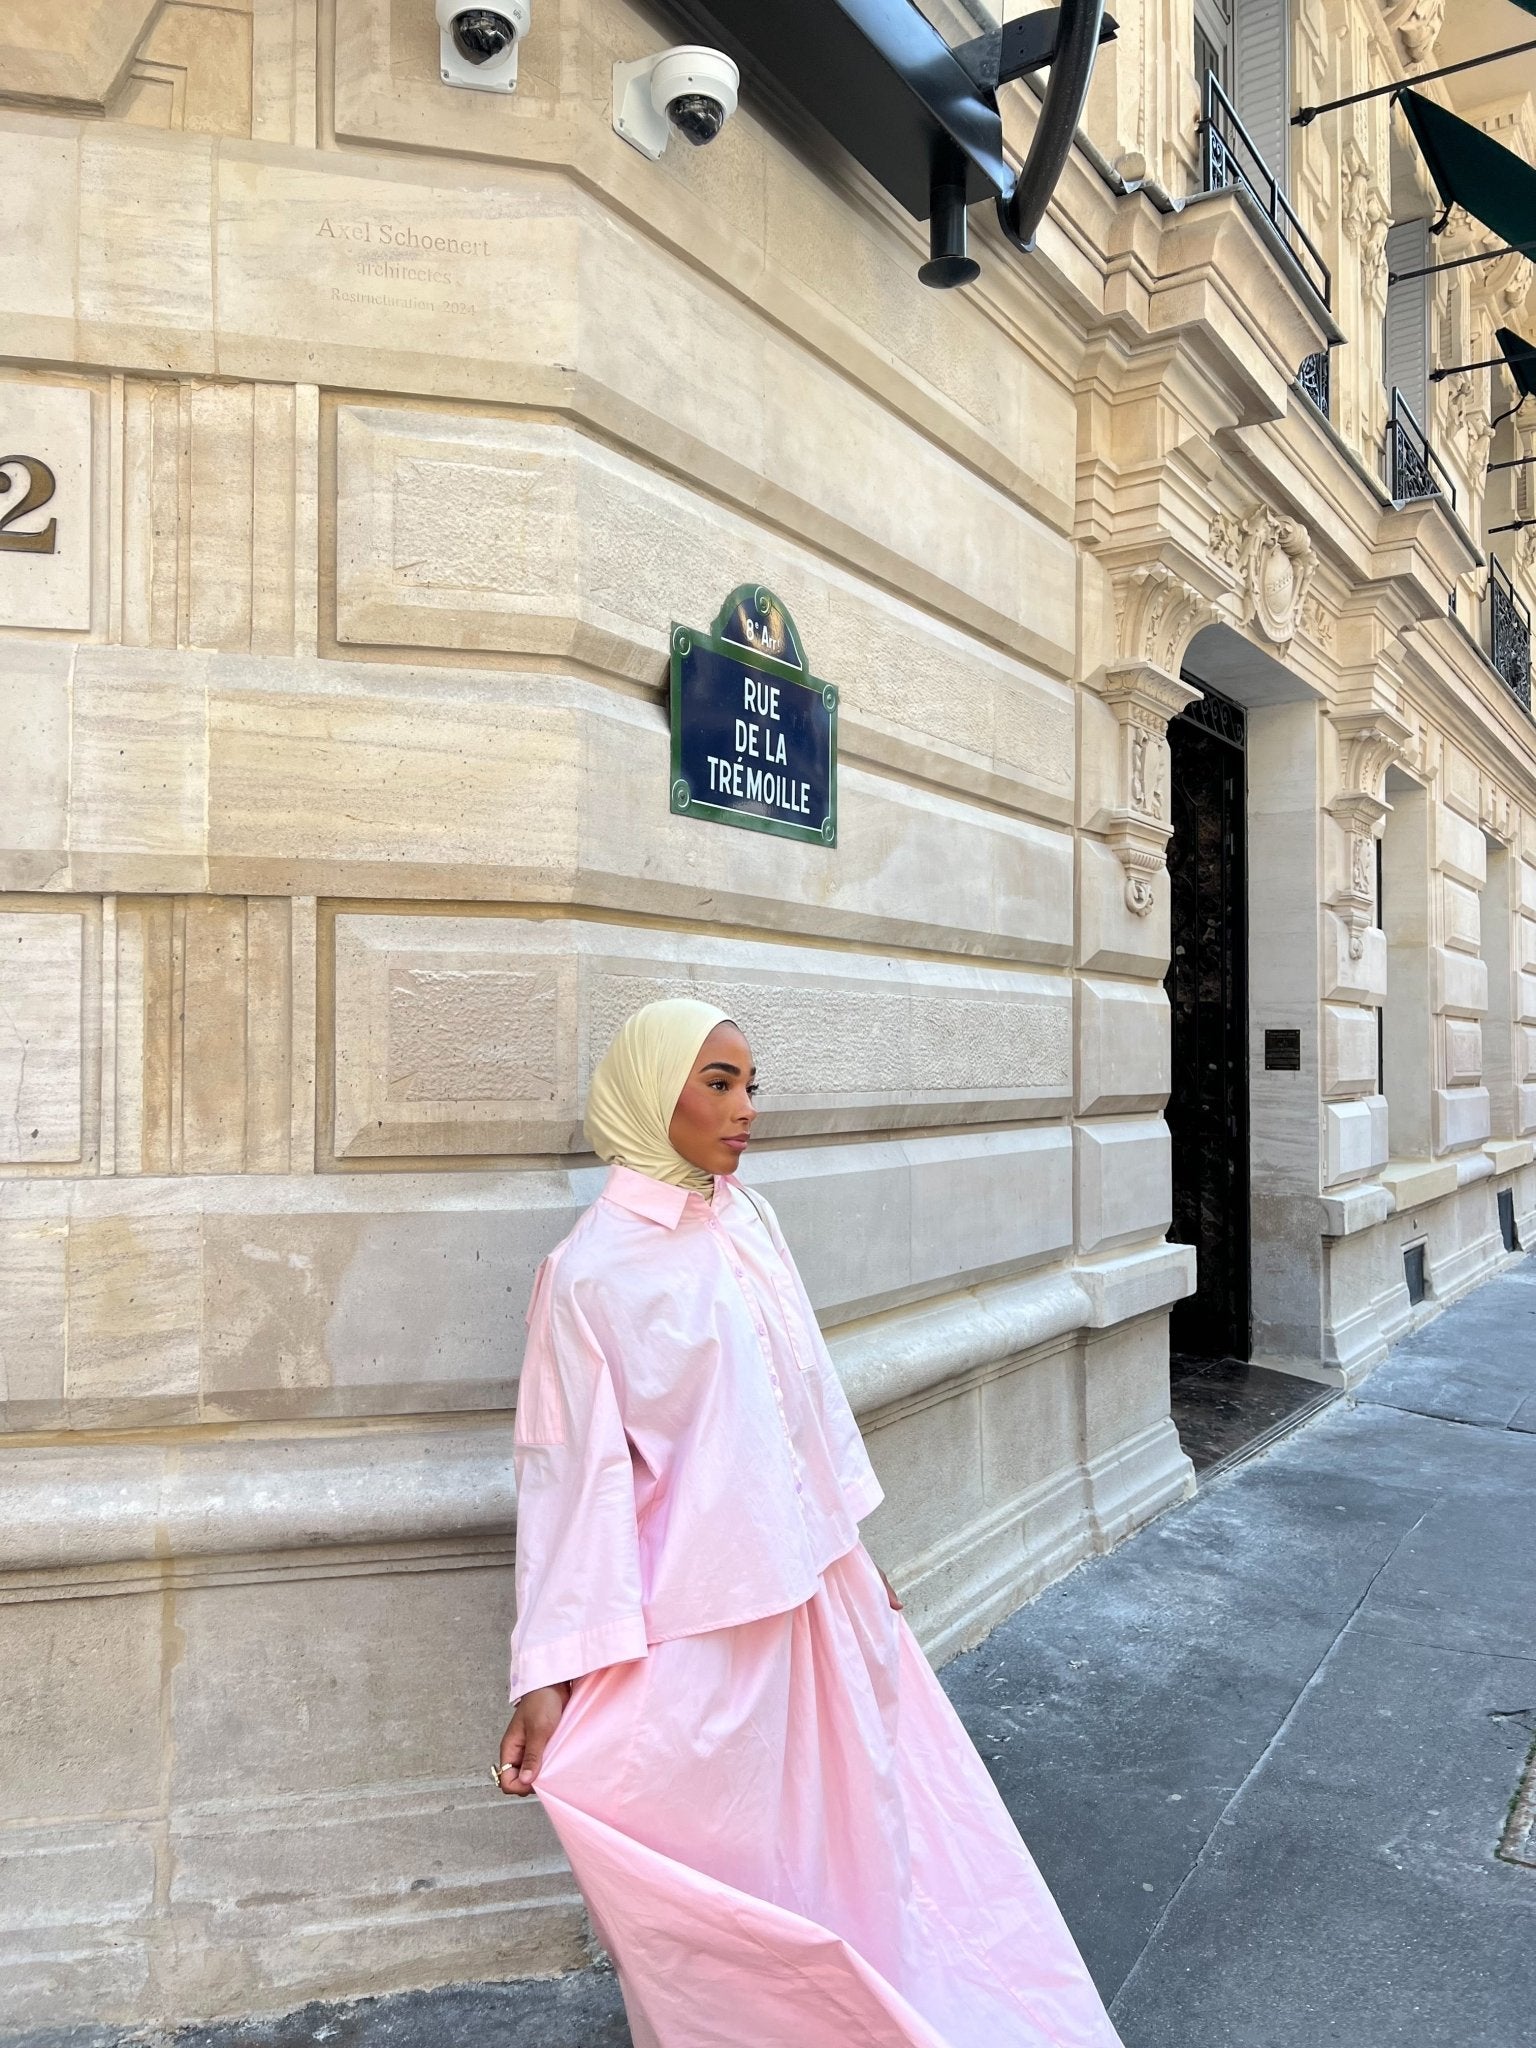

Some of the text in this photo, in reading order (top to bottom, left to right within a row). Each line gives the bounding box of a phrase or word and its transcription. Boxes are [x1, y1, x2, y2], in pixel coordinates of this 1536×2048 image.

[315, 217, 492, 257] Axel Schoenert
[356, 260, 452, 286] architectes
[331, 287, 478, 317] Restructuration 2024
[0, 454, 57, 555] 2
[744, 676, 781, 721] RUE
[735, 718, 788, 766] DE LA
[706, 756, 811, 815] TRÉMOILLE
